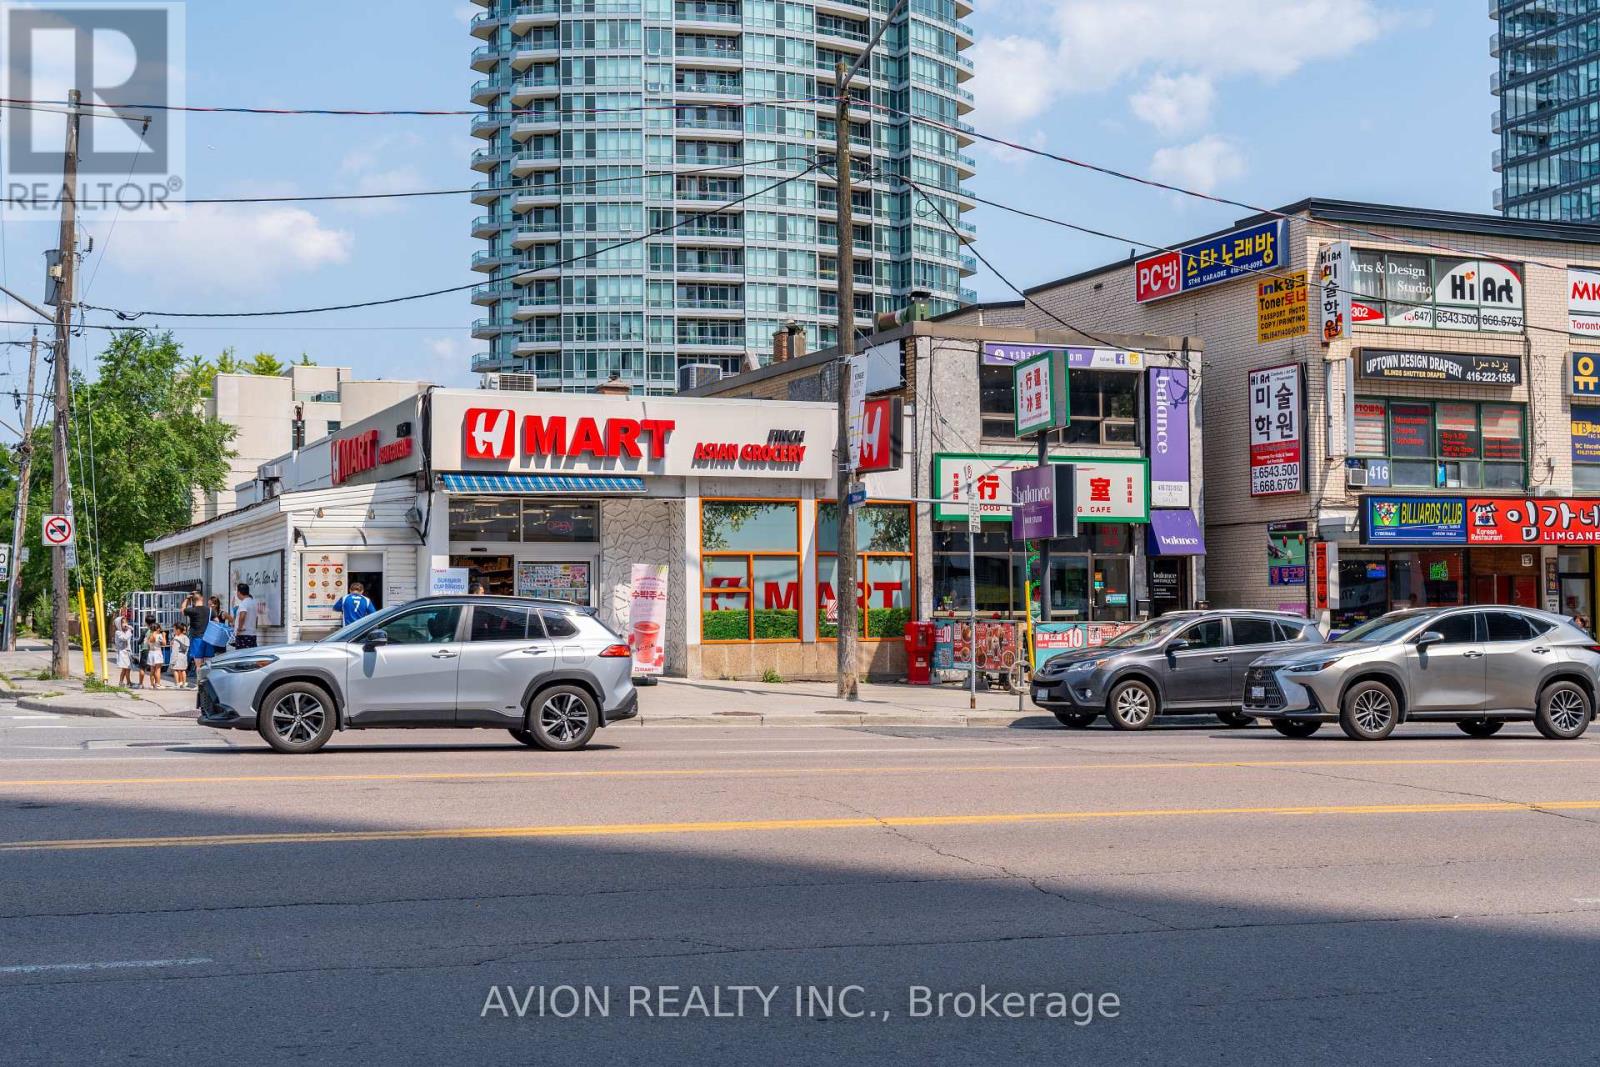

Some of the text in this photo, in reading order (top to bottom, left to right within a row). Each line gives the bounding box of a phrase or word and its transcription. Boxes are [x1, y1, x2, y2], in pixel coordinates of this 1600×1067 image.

[1350, 260, 1425, 279] Arts & Design
[1139, 260, 1178, 294] PC방
[1397, 281, 1432, 294] Studio
[1451, 272, 1513, 303] Hi Art
[1289, 305, 1305, 315] PHOTO
[1437, 314, 1479, 325] 6543.500
[1483, 313, 1522, 327] 668.6767
[1366, 354, 1462, 378] UPTOWN DESIGN DRAPERY
[1260, 373, 1270, 384] Art
[1466, 372, 1515, 383] 416-222-1554
[1156, 375, 1168, 454] balance
[469, 408, 675, 459] H MART
[768, 429, 805, 443] FINCH
[340, 430, 378, 478] MART
[695, 442, 806, 463] ASIAN GROCERY
[1369, 466, 1389, 480] 416
[1016, 485, 1050, 503] balance
[1401, 502, 1463, 525] BILLIARDS CLUB
[1161, 535, 1198, 545] balance
[1544, 531, 1600, 540] LIMGANE
[632, 590, 665, 600] 수박주스
[353, 600, 361, 612] 7
